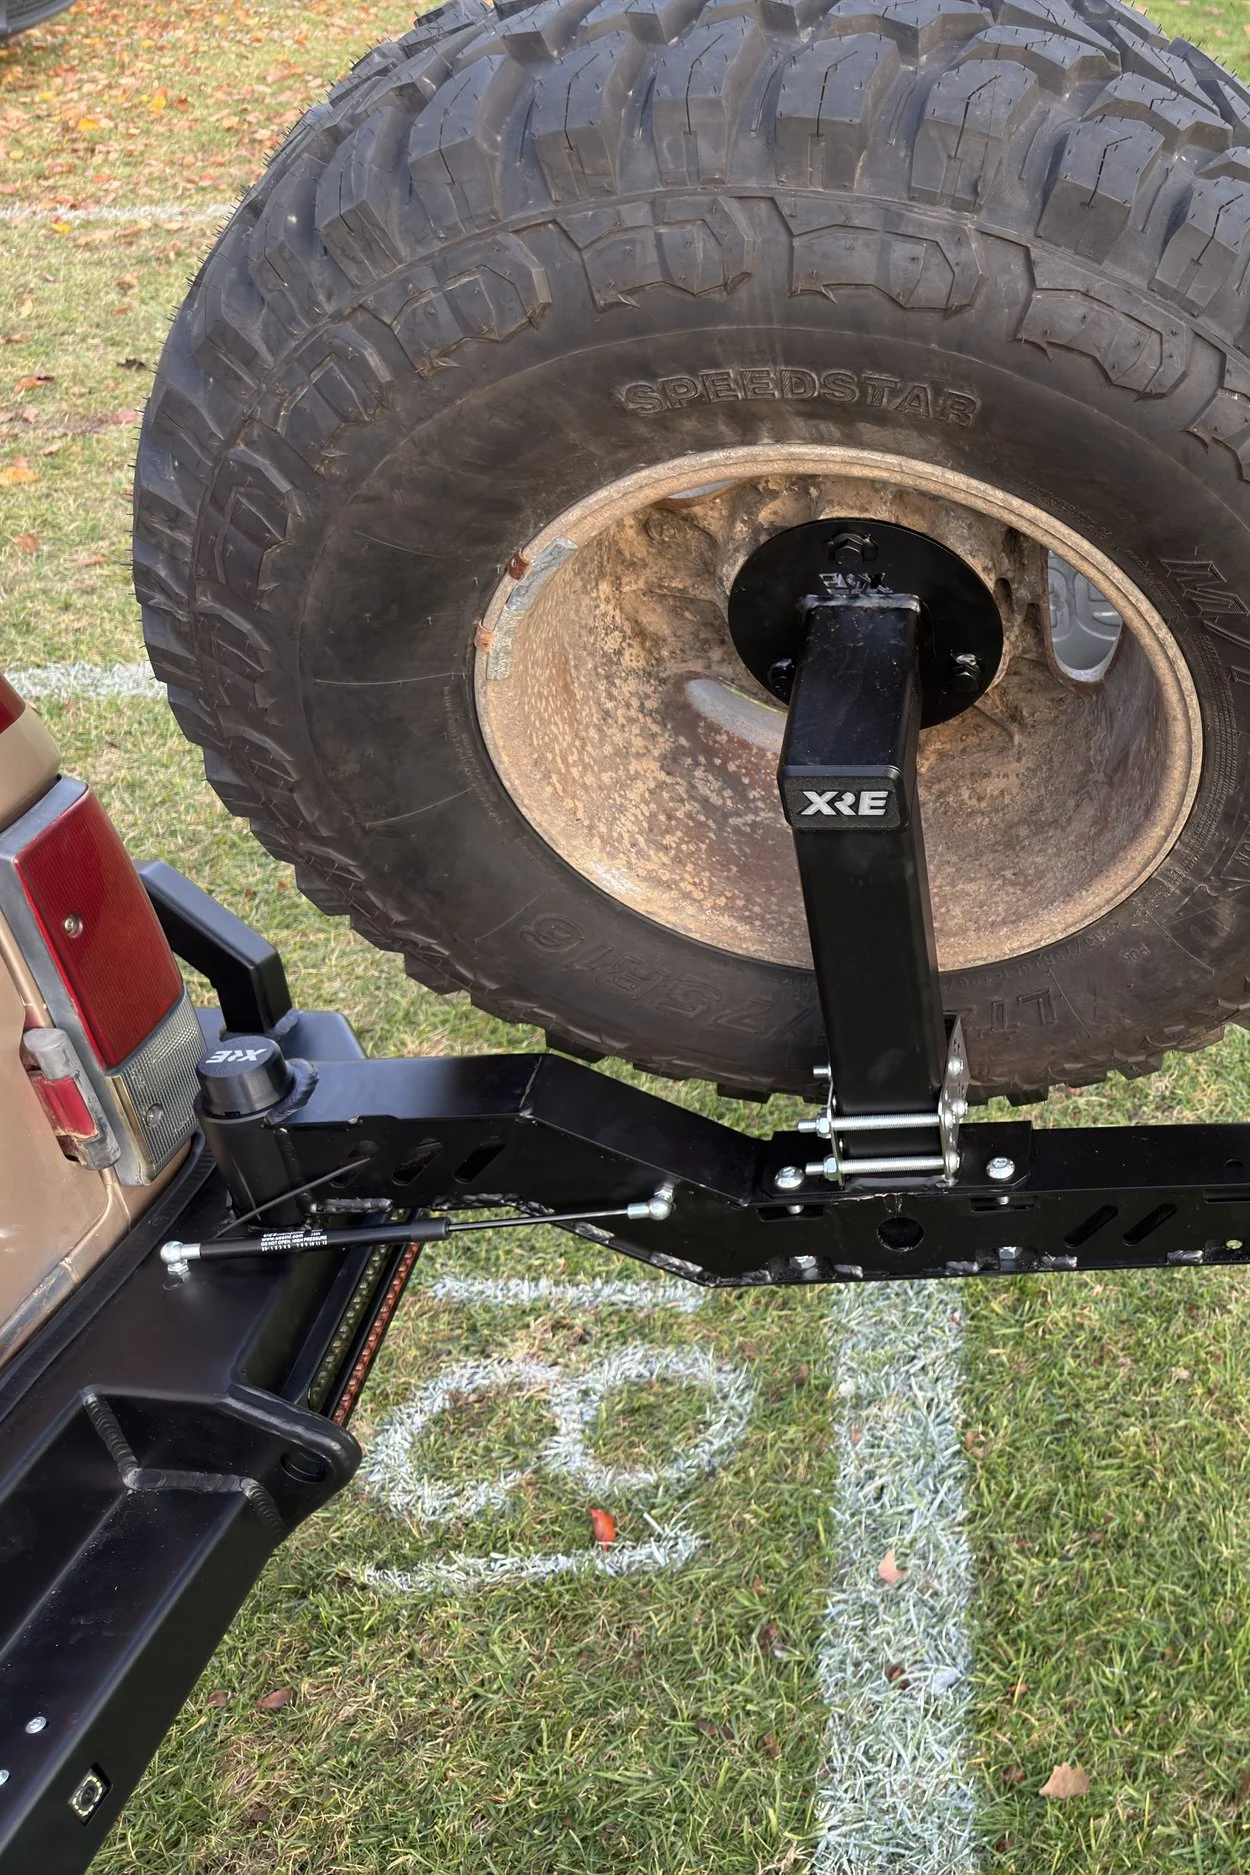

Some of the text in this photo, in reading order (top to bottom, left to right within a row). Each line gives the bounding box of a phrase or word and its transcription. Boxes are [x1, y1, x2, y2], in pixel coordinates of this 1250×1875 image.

[622, 367, 981, 427] SPEEDSTAR
[799, 790, 889, 817] XRE
[205, 1048, 268, 1064] XRE
